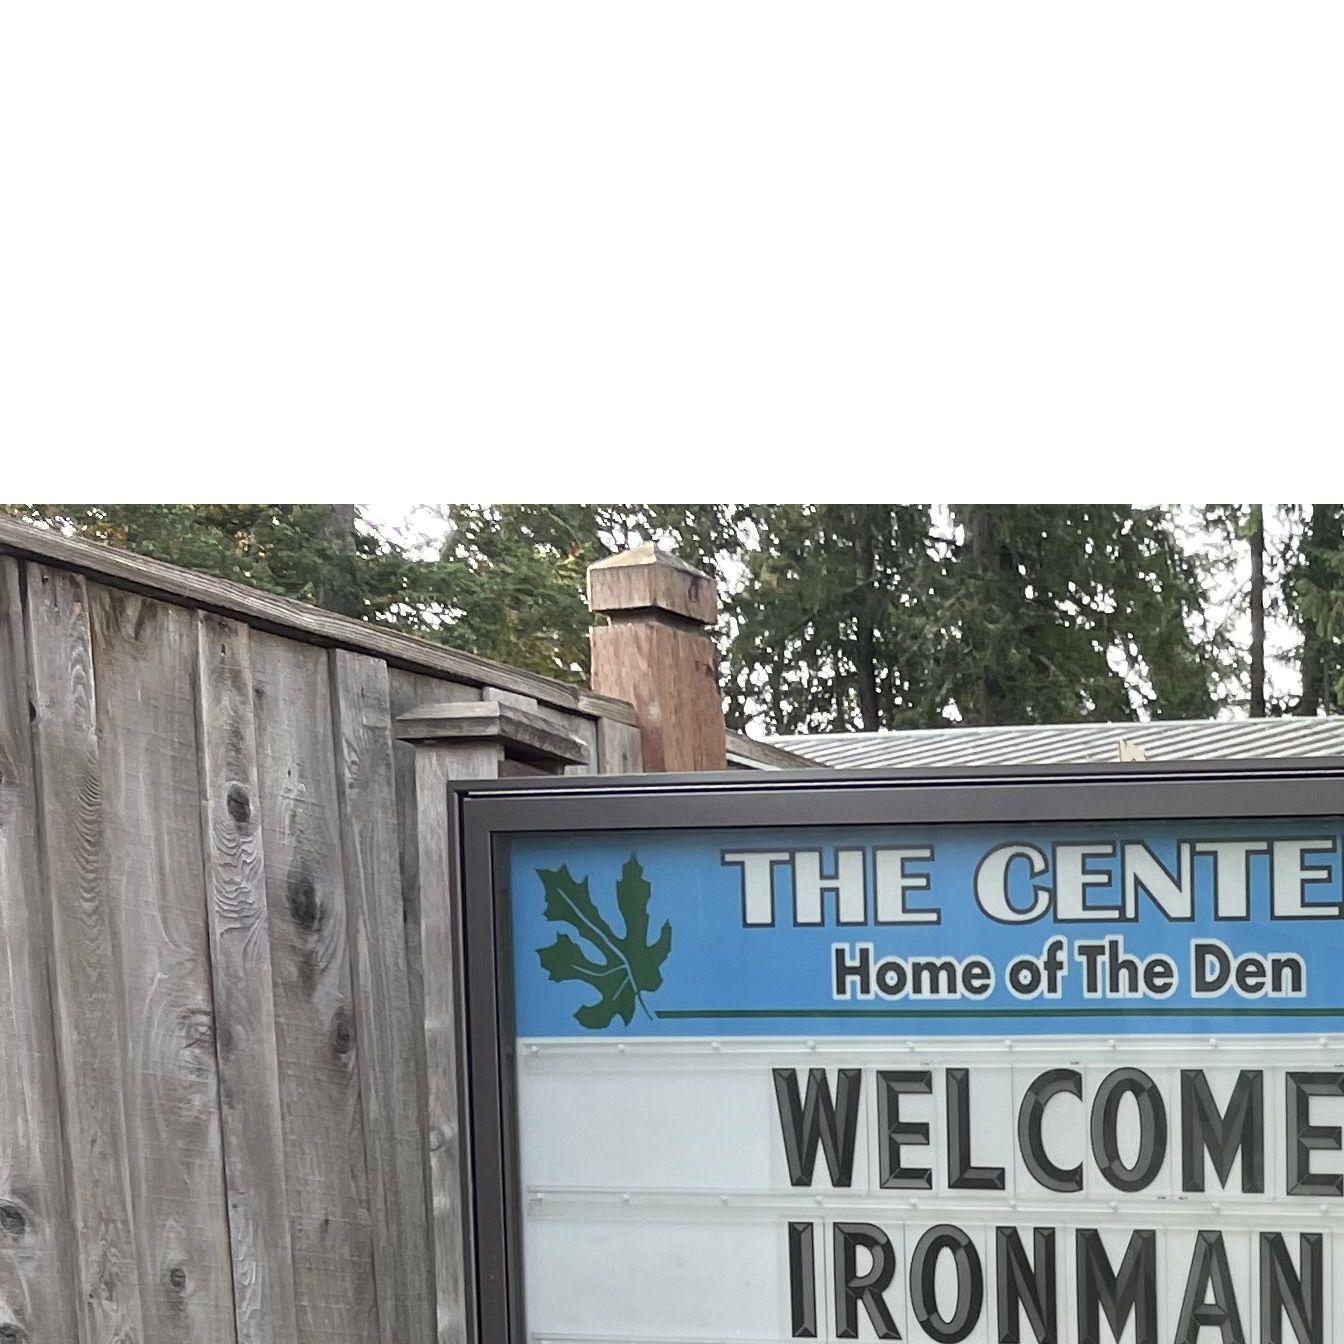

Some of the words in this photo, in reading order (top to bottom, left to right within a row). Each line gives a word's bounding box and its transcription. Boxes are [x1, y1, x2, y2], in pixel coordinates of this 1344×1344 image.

[722, 841, 941, 926] THE
[833, 942, 997, 1002] Home
[1007, 937, 1070, 998] of
[1078, 936, 1180, 997] The
[1190, 937, 1306, 996] Den
